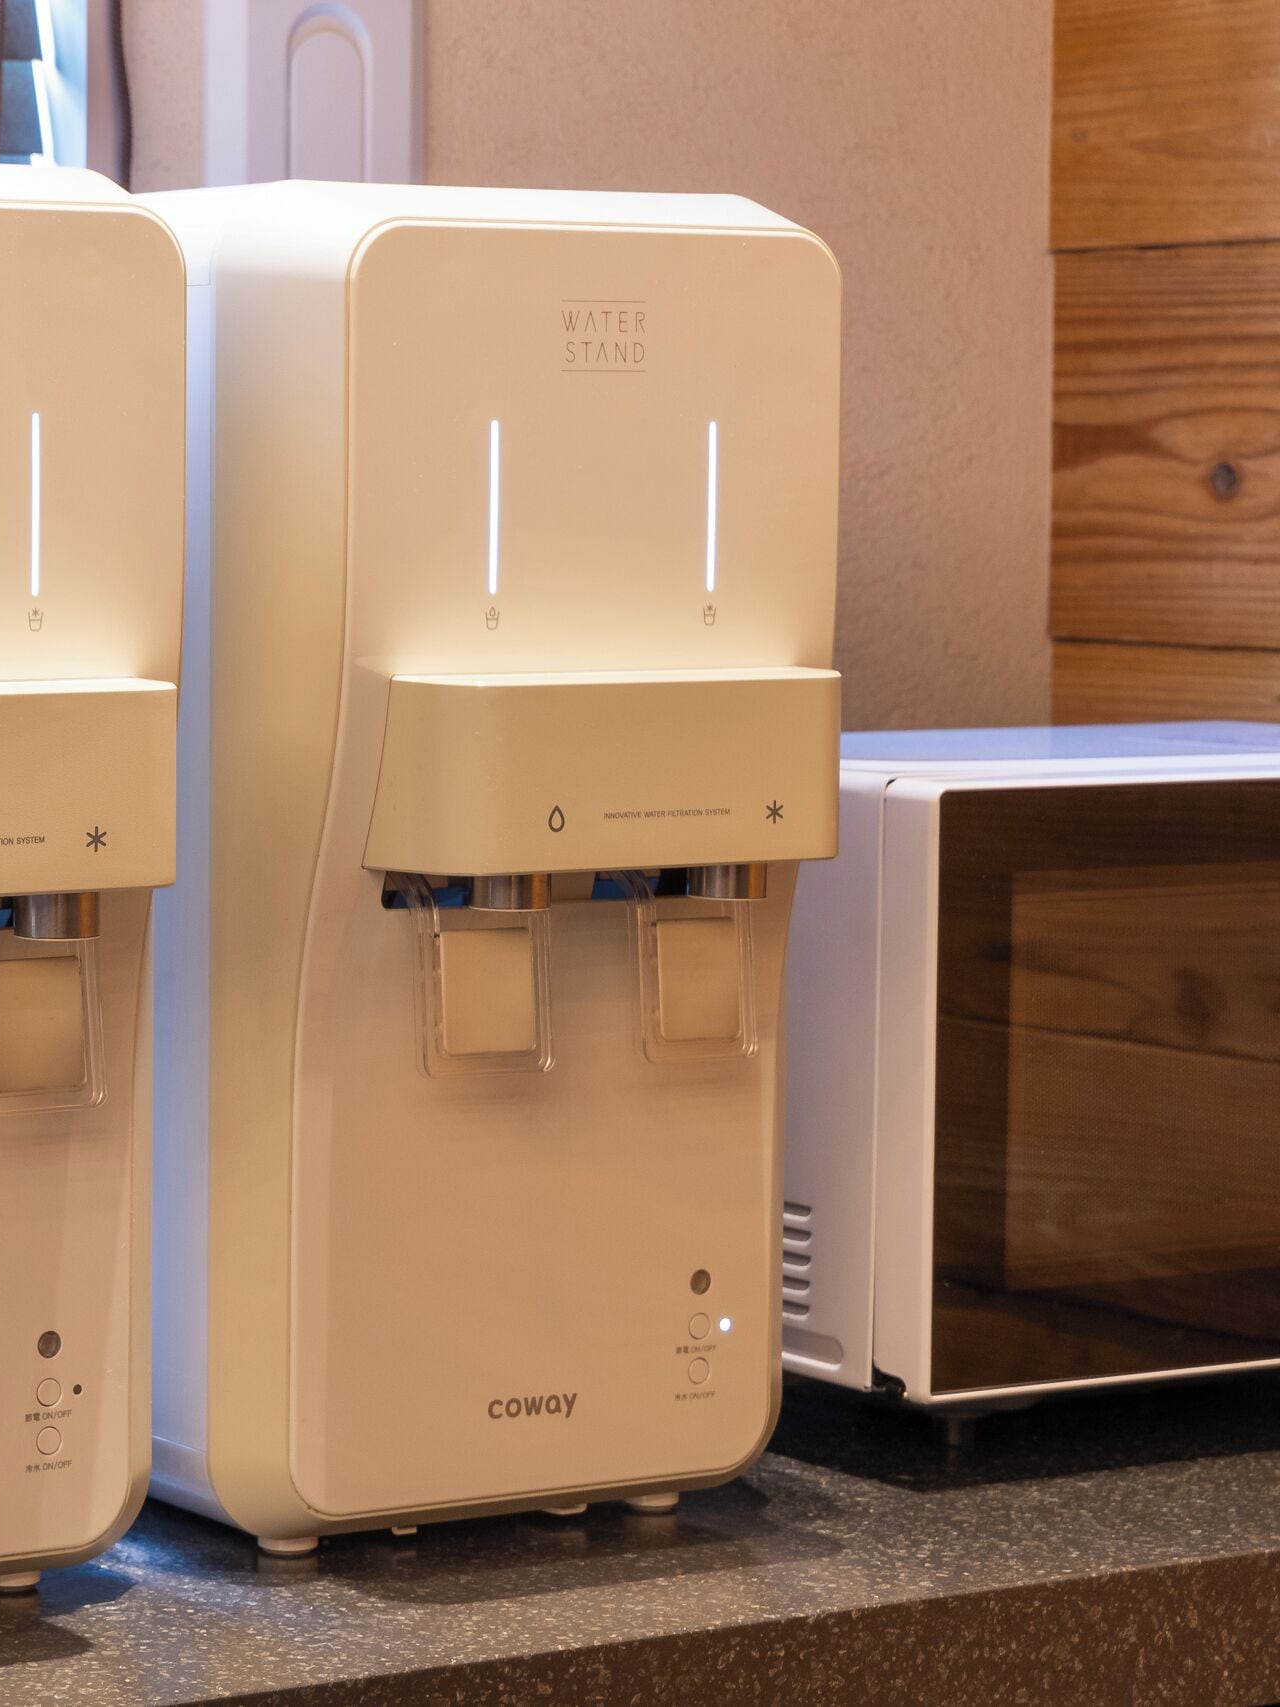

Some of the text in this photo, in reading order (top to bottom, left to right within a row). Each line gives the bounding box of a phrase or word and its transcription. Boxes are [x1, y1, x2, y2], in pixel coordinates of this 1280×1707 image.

[561, 310, 646, 333] WATER
[565, 341, 645, 364] STAND
[603, 807, 731, 820] INNOVATIVE WATER FILTRATION SYSTEM
[16, 835, 45, 845] SYSTEM
[487, 1392, 578, 1419] coway
[42, 1409, 72, 1420] ON/OFF
[42, 1460, 72, 1471] ON/OFF
